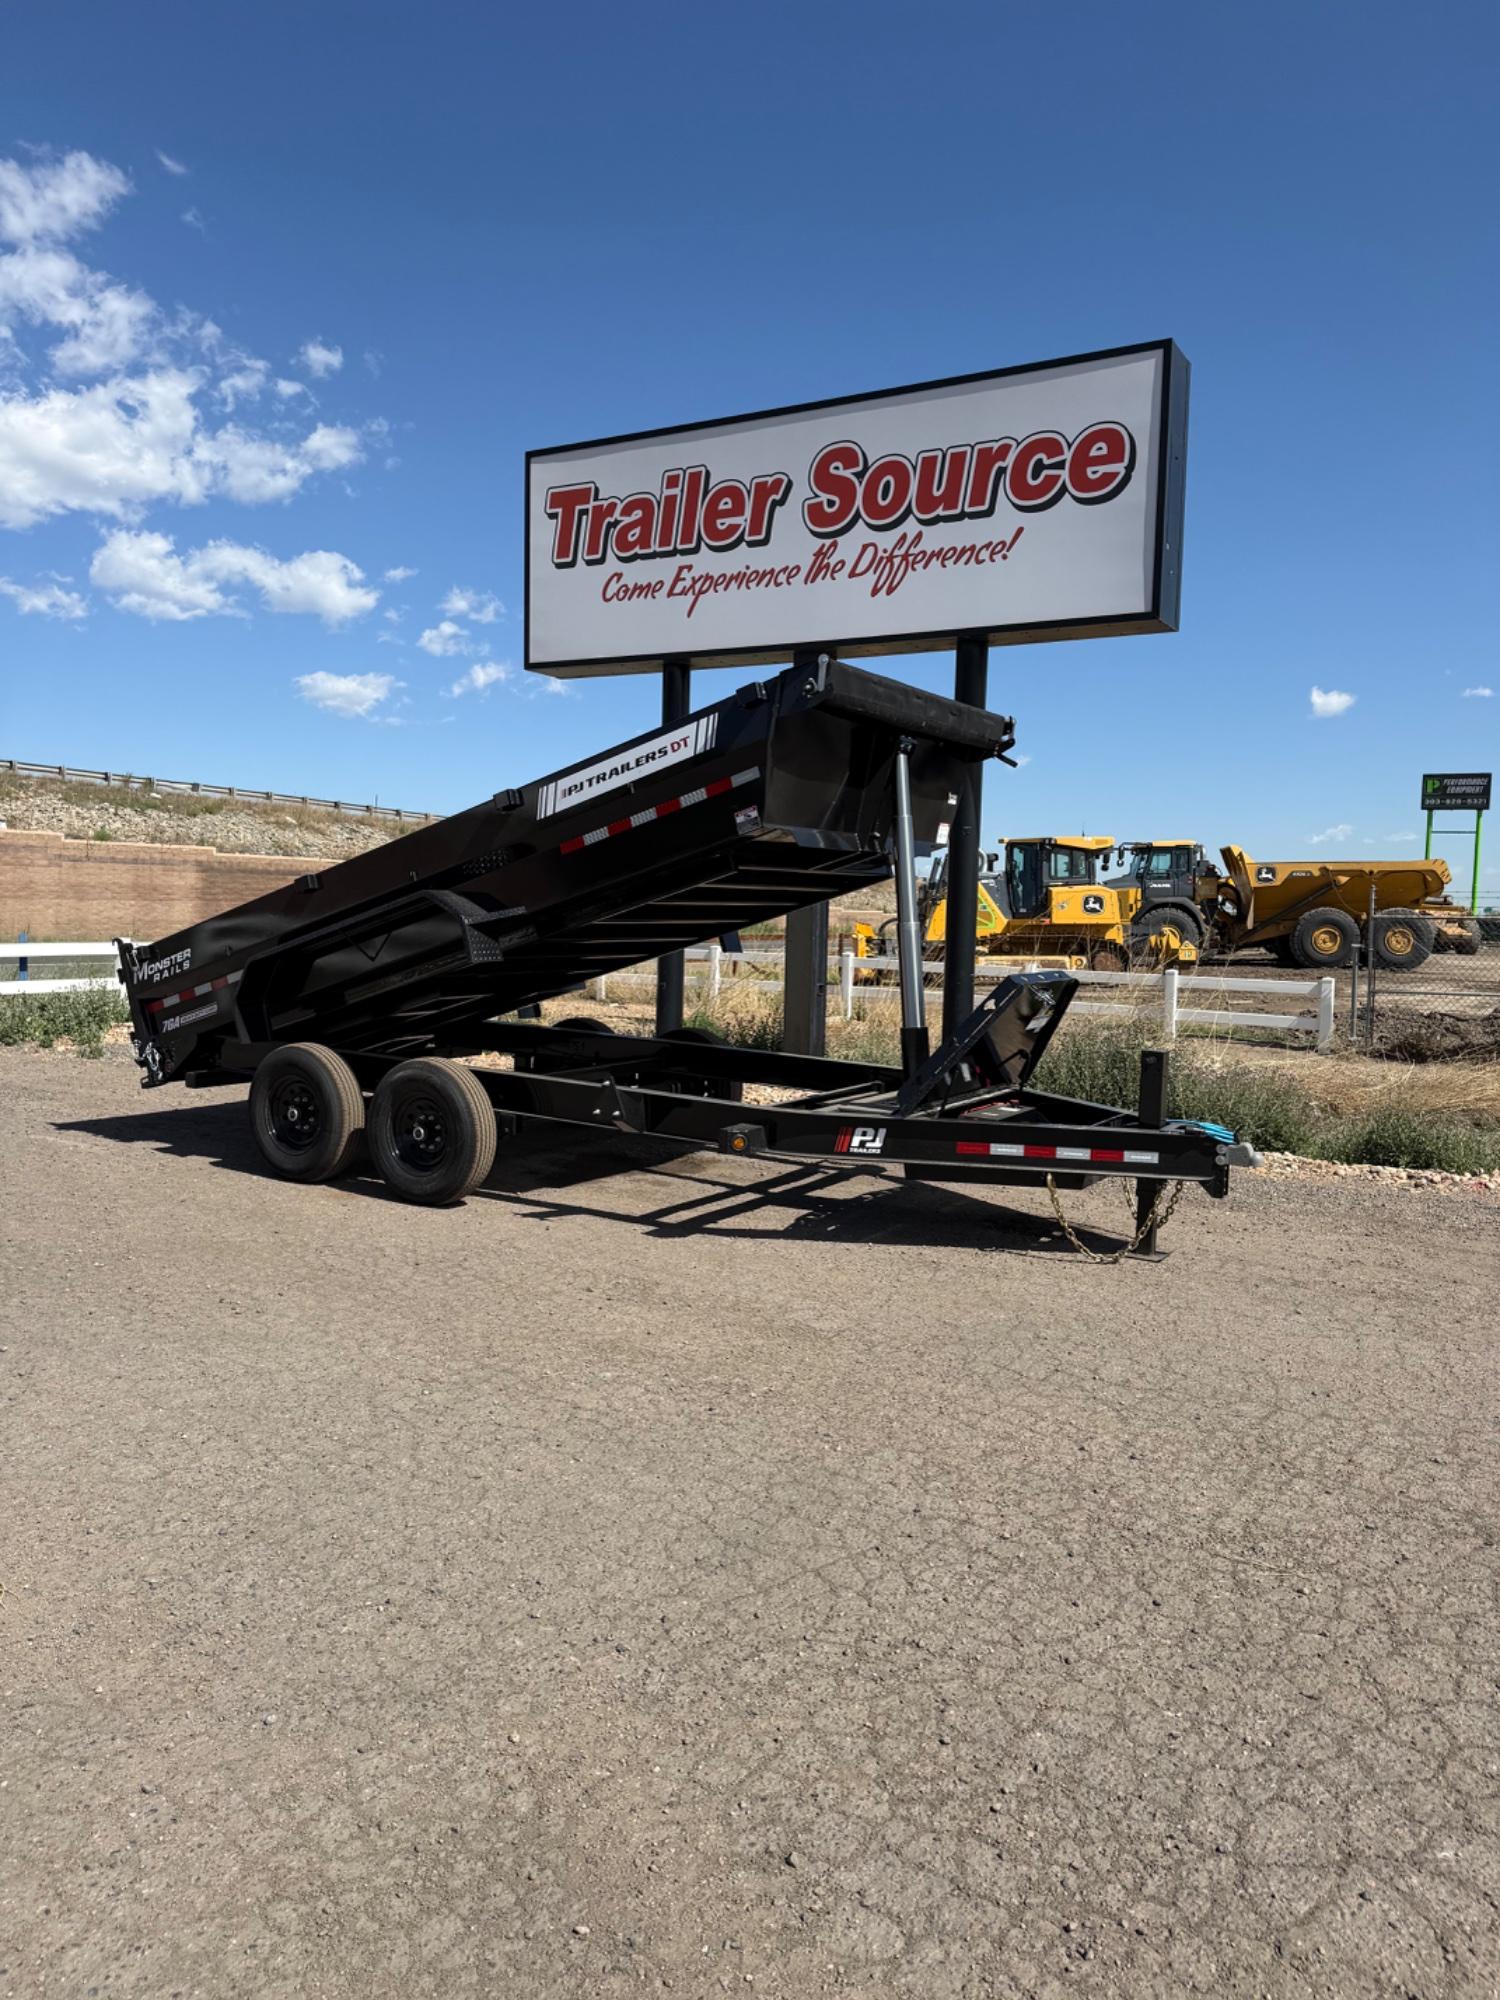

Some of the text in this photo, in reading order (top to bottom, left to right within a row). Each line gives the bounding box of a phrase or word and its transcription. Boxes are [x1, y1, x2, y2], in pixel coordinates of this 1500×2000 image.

[545, 421, 1136, 567] Trailer Source
[602, 526, 1025, 619] Come Experience the Difference!
[585, 746, 669, 788] TRAILERS
[670, 735, 690, 753] DT
[1443, 777, 1488, 786] PERFORMANCE
[1446, 785, 1484, 794] EQUIPMENT
[133, 948, 192, 985] MONSTER
[153, 959, 190, 983] RAILS
[850, 1127, 887, 1148] PJ
